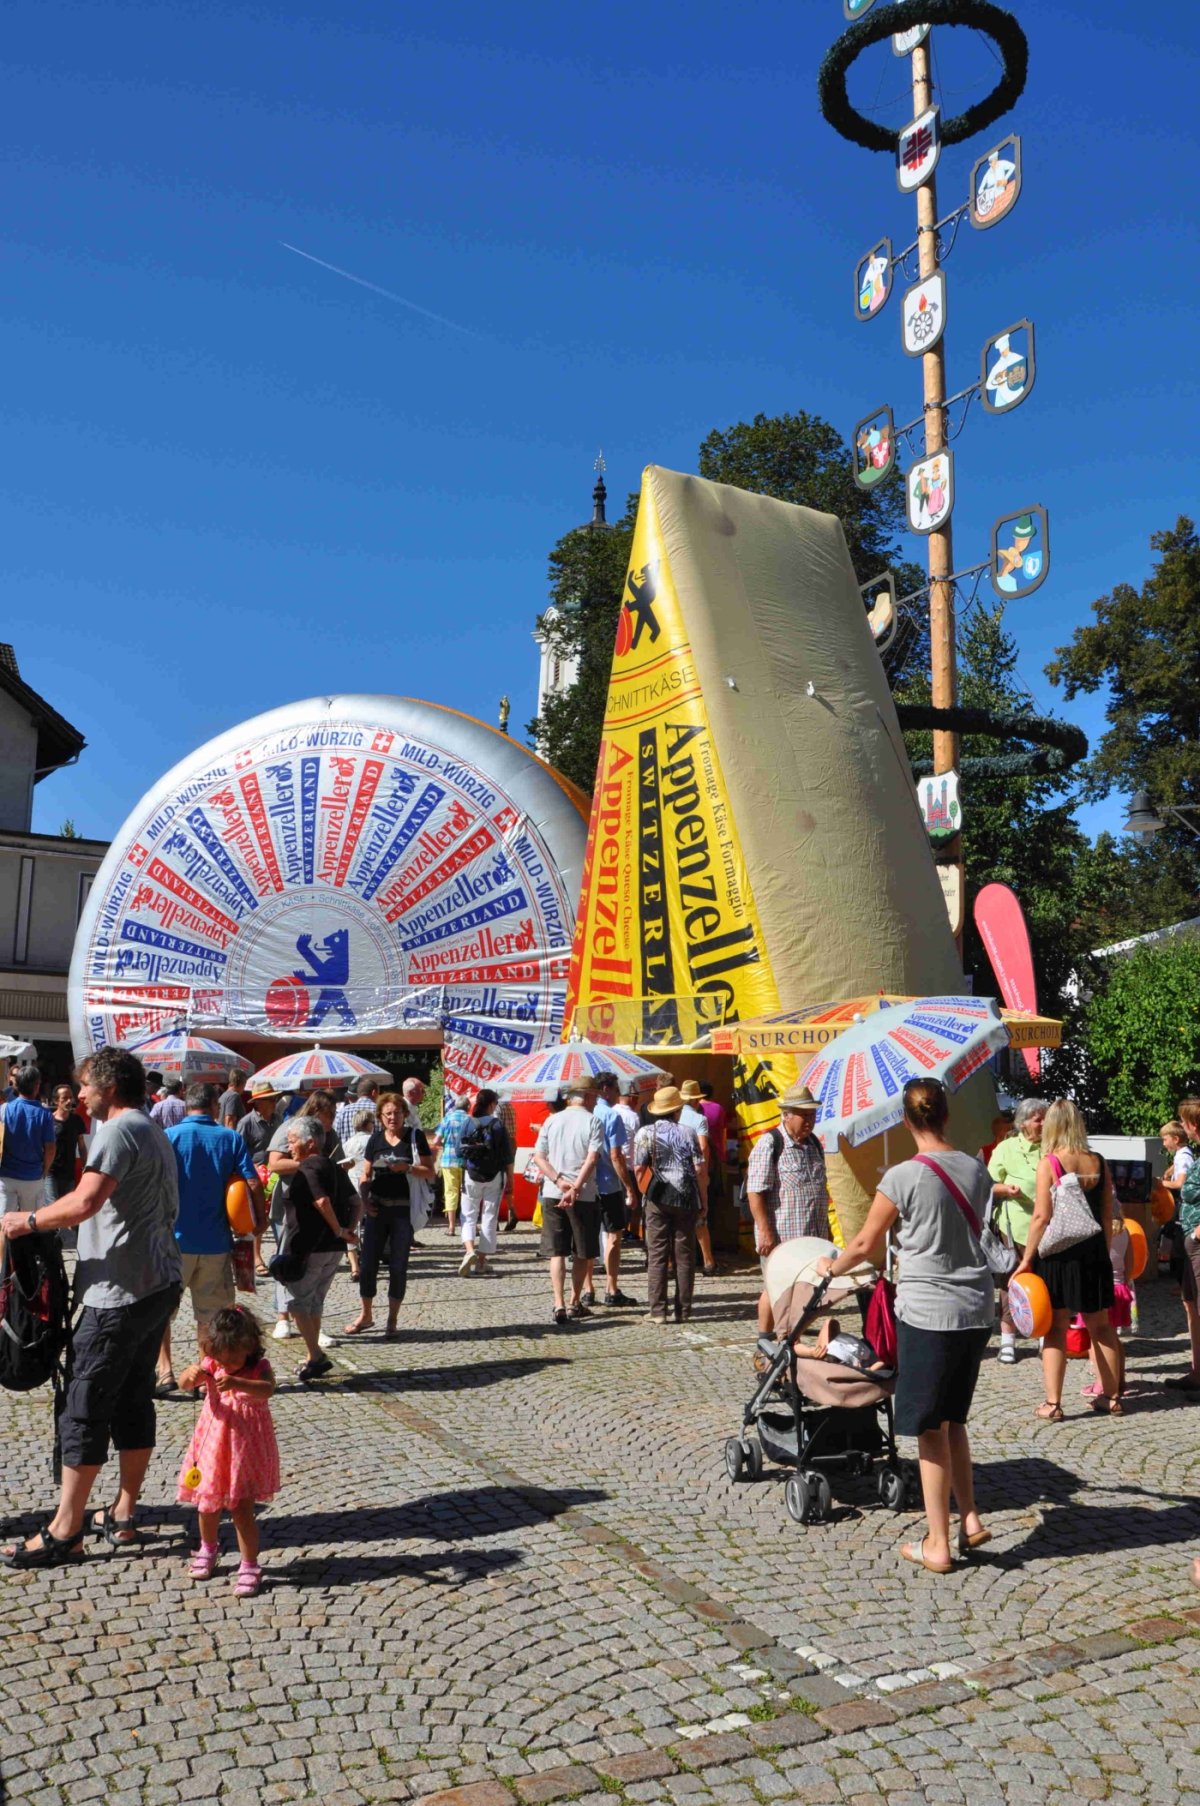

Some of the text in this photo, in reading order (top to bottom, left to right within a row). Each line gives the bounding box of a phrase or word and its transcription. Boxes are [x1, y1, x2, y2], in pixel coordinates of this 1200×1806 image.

[607, 665, 696, 714] CHNITTKÄSE
[262, 730, 363, 758] ILD-WÜRZIG
[400, 743, 496, 810] MILD-WÜRZIG
[221, 804, 274, 898] Appenzeller
[243, 778, 283, 889] SWITZERLAND
[269, 780, 301, 886] Appenzeller
[304, 762, 318, 880] SWITZERLAND
[316, 777, 350, 886] Appenzeller
[336, 765, 379, 884] SWITZERLAND
[348, 788, 406, 894] Appenzeller
[365, 790, 440, 896] SWITZERLAND
[699, 740, 745, 918] Fromage Käse Formaggio
[181, 843, 251, 921] Appenzeller
[191, 814, 256, 908] SWITZERLAND
[374, 822, 458, 913] Appenzeller
[389, 833, 488, 919] SWITZERLAND
[513, 836, 566, 950] MILD-WÜRZIG
[93, 871, 133, 975] MILD-WÜRZIG
[150, 891, 233, 950] Appenzeller
[152, 864, 236, 932] SWITZERLAND
[397, 867, 496, 940] Appenzeller
[406, 893, 521, 949] SWITZERLAND
[624, 906, 633, 950] Cheese
[641, 744, 674, 1046] SWITZERLAN
[126, 924, 224, 962] SWITZERLAND
[135, 949, 226, 983] Appenzeller
[408, 927, 515, 973] Appenzeller
[413, 965, 535, 983] SWITZERLAND
[443, 1018, 528, 1049] ZERLAND
[749, 1029, 844, 1048] SURCHOI
[896, 1026, 940, 1059] Appenzeller
[911, 1012, 965, 1033] Appenzeller
[1014, 1025, 1060, 1042] SURCHOIX
[444, 1042, 503, 1081] nzeller
[879, 1039, 910, 1079] Appenzeller
[856, 1106, 905, 1140] MILD-WÜR
